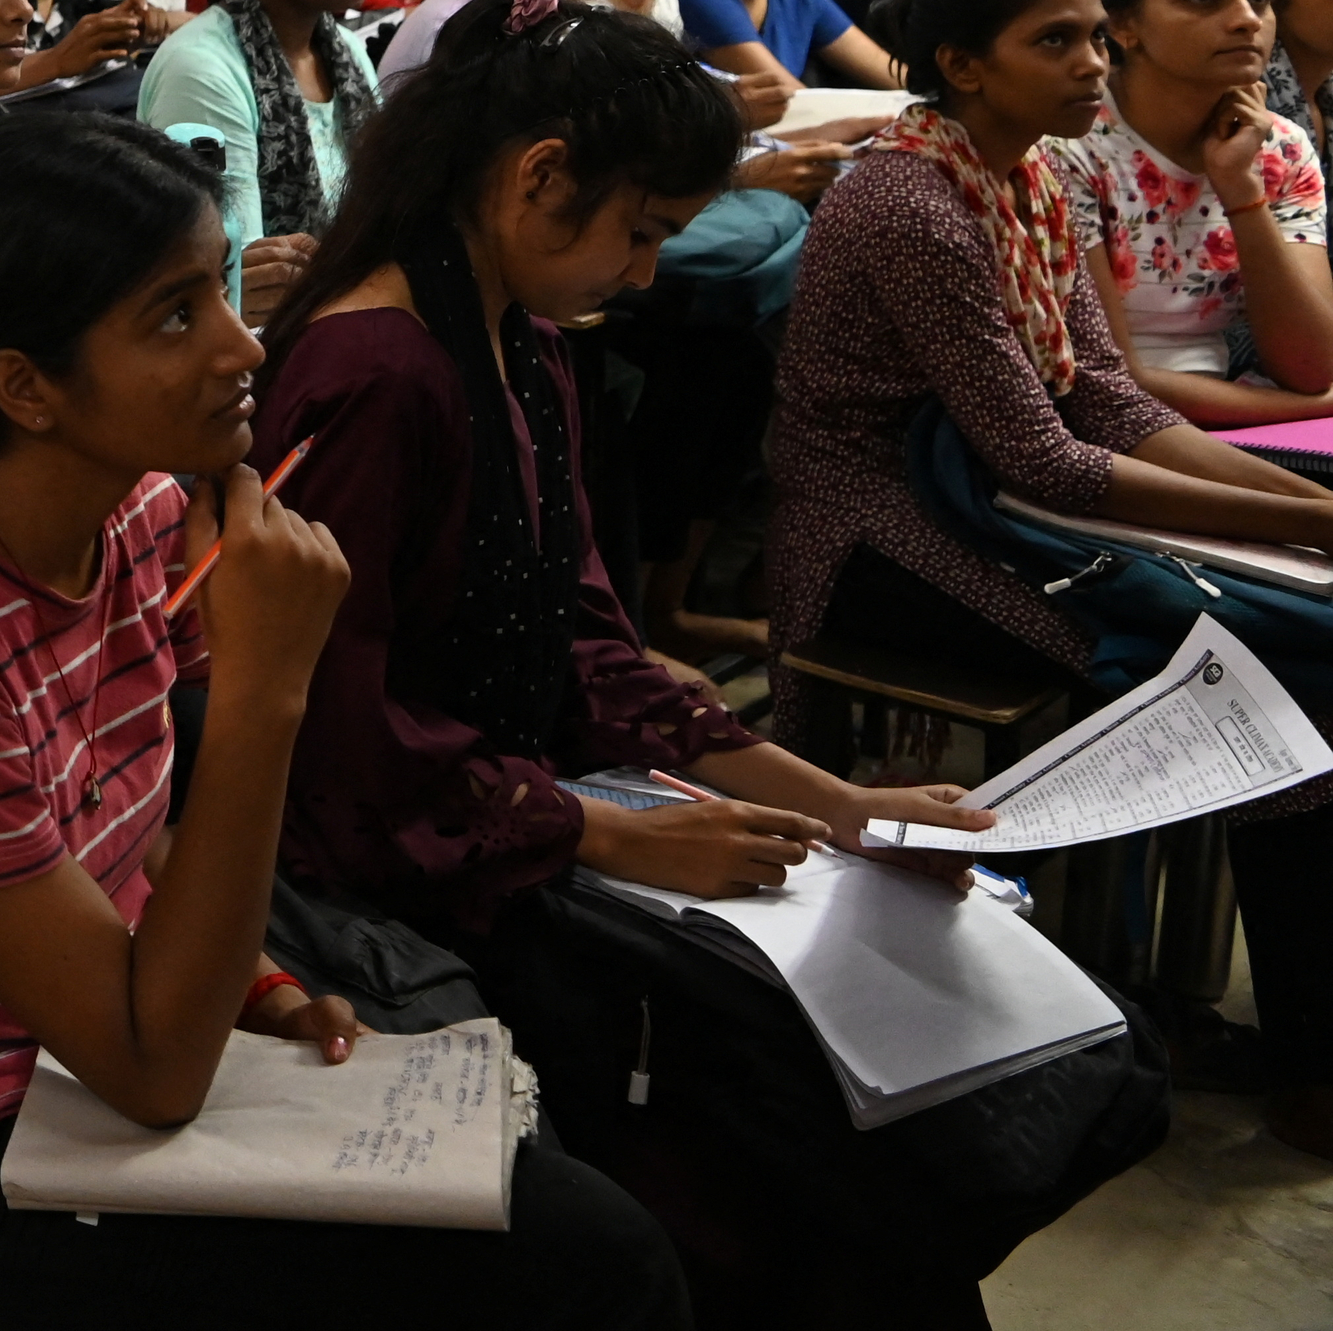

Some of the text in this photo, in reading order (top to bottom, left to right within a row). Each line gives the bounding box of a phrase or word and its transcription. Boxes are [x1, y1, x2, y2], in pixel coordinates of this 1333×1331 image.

[989, 795, 1006, 808] Climax
[1005, 781, 1026, 797] Academy
[1026, 771, 1043, 783] Climax
[1042, 758, 1063, 773] Academy
[1064, 746, 1081, 759] Climax
[1081, 733, 1102, 748] Academy
[1102, 720, 1119, 734] Climax
[1119, 707, 1140, 722] Academy
[1227, 698, 1251, 726] SUPER
[1245, 722, 1270, 752] CLIMAX
